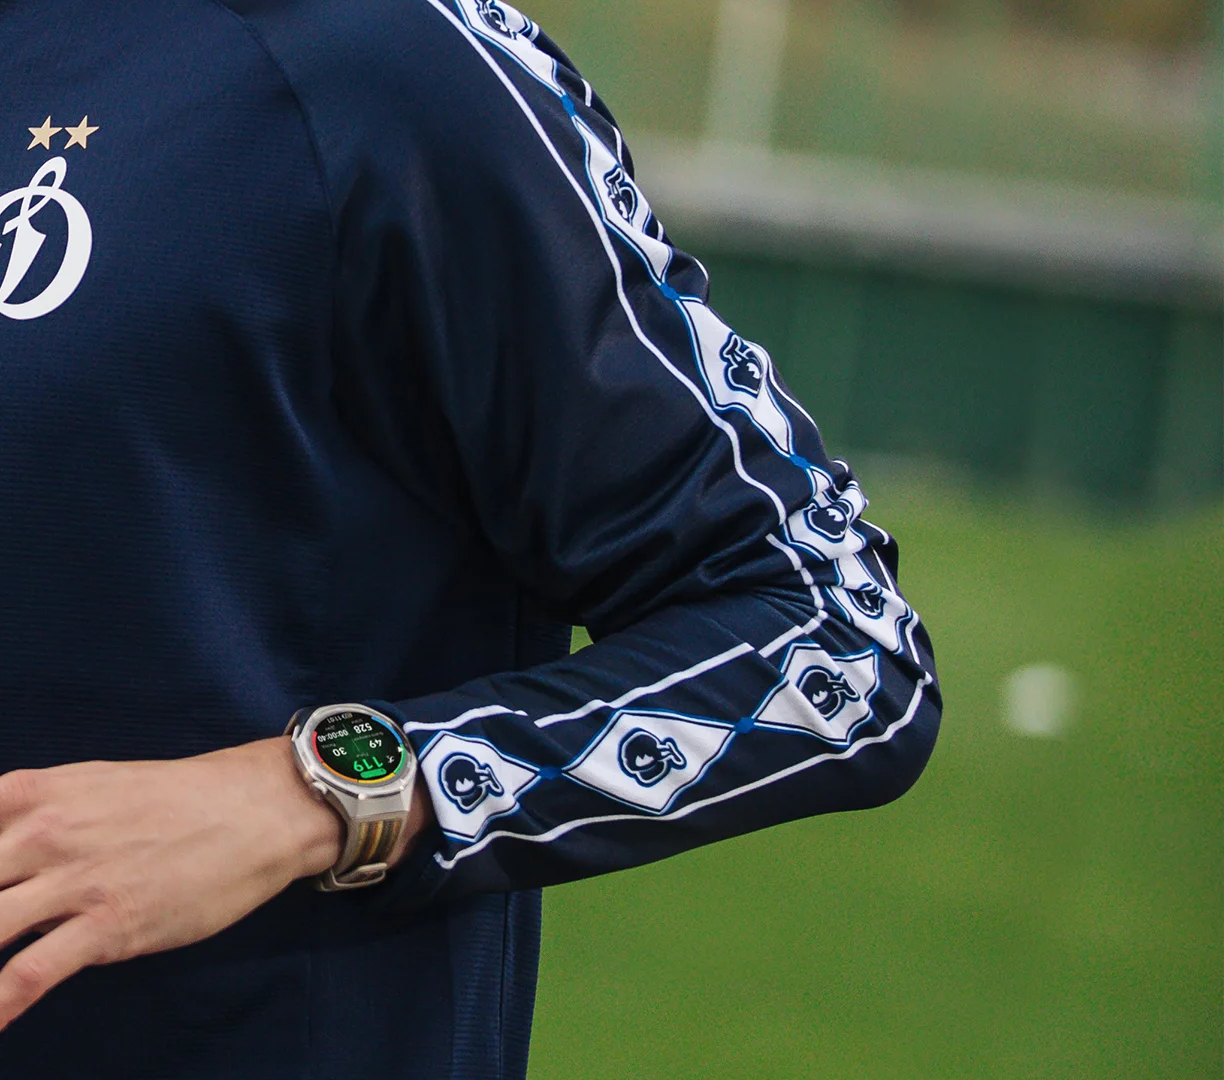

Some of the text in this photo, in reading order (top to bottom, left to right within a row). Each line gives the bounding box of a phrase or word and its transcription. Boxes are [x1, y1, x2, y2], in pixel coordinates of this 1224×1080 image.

[353, 722, 373, 734] 528
[369, 738, 382, 749] 49
[332, 746, 347, 757] 30
[353, 756, 383, 772] 119
